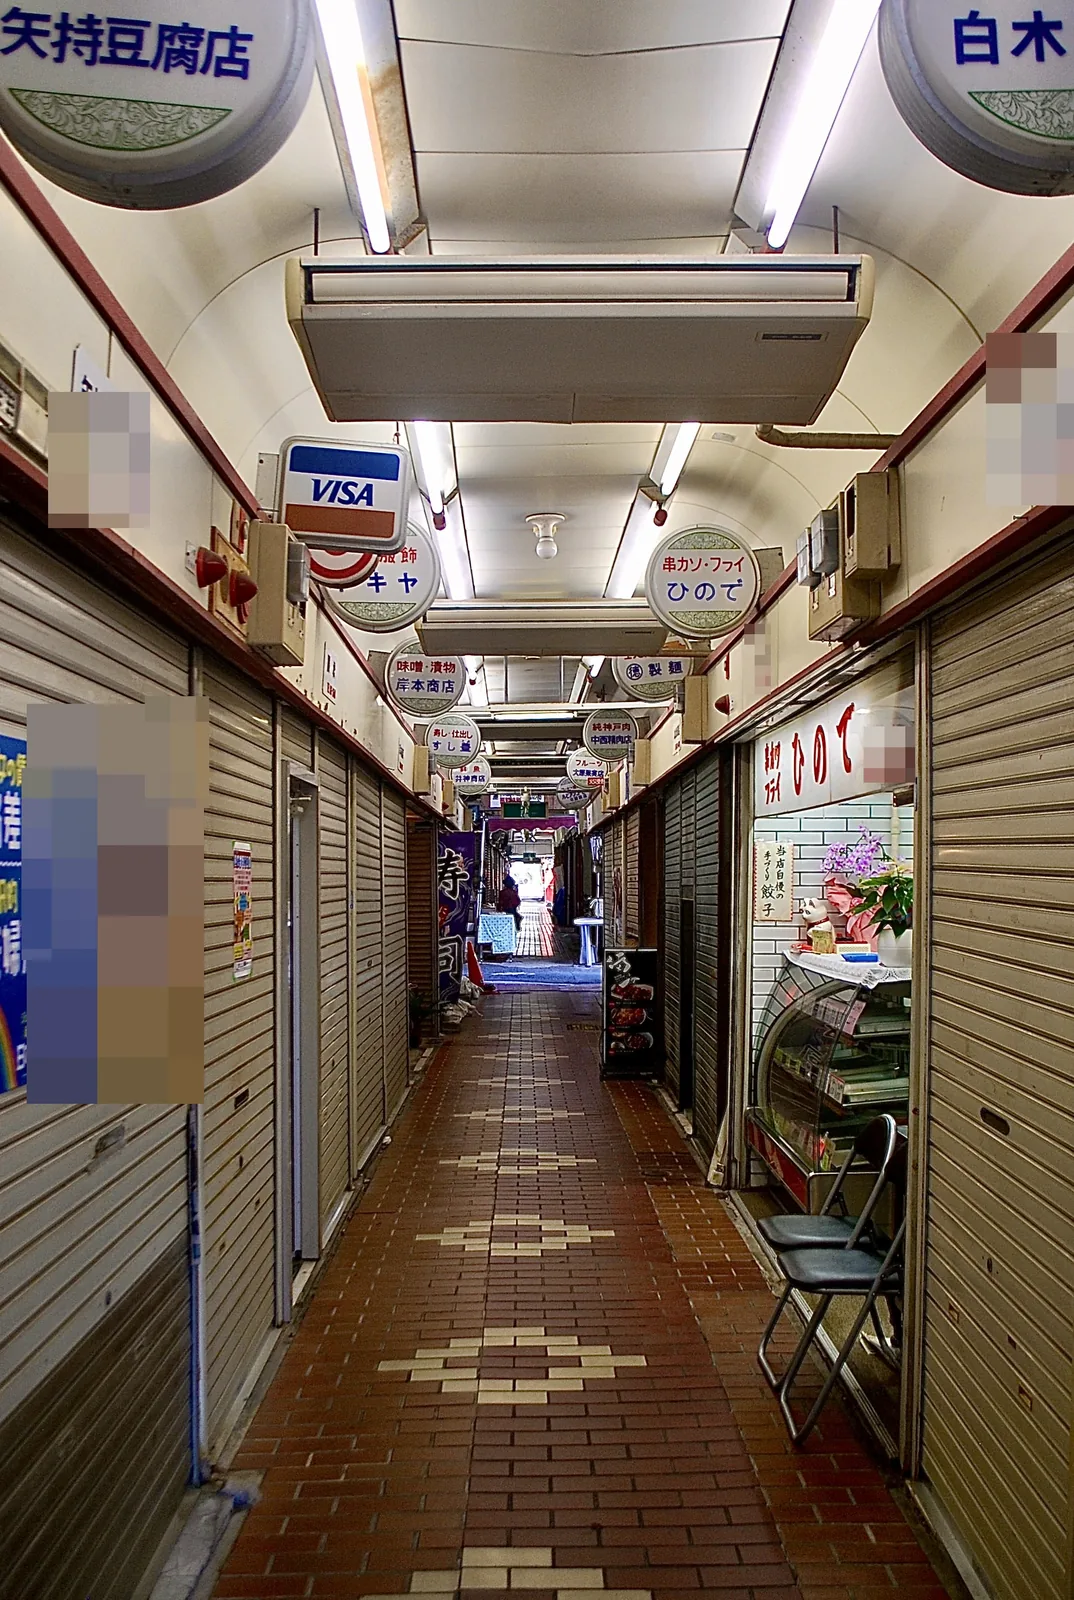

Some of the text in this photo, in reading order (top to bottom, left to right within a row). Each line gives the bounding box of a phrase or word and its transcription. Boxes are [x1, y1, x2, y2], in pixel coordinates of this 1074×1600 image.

[0, 6, 253, 81] 矢持豆腐店
[952, 9, 1067, 66] 白木
[311, 478, 375, 507] VISA
[339, 571, 418, 594] キヤ
[667, 578, 744, 602] ひので
[395, 677, 456, 693] 岸本商店
